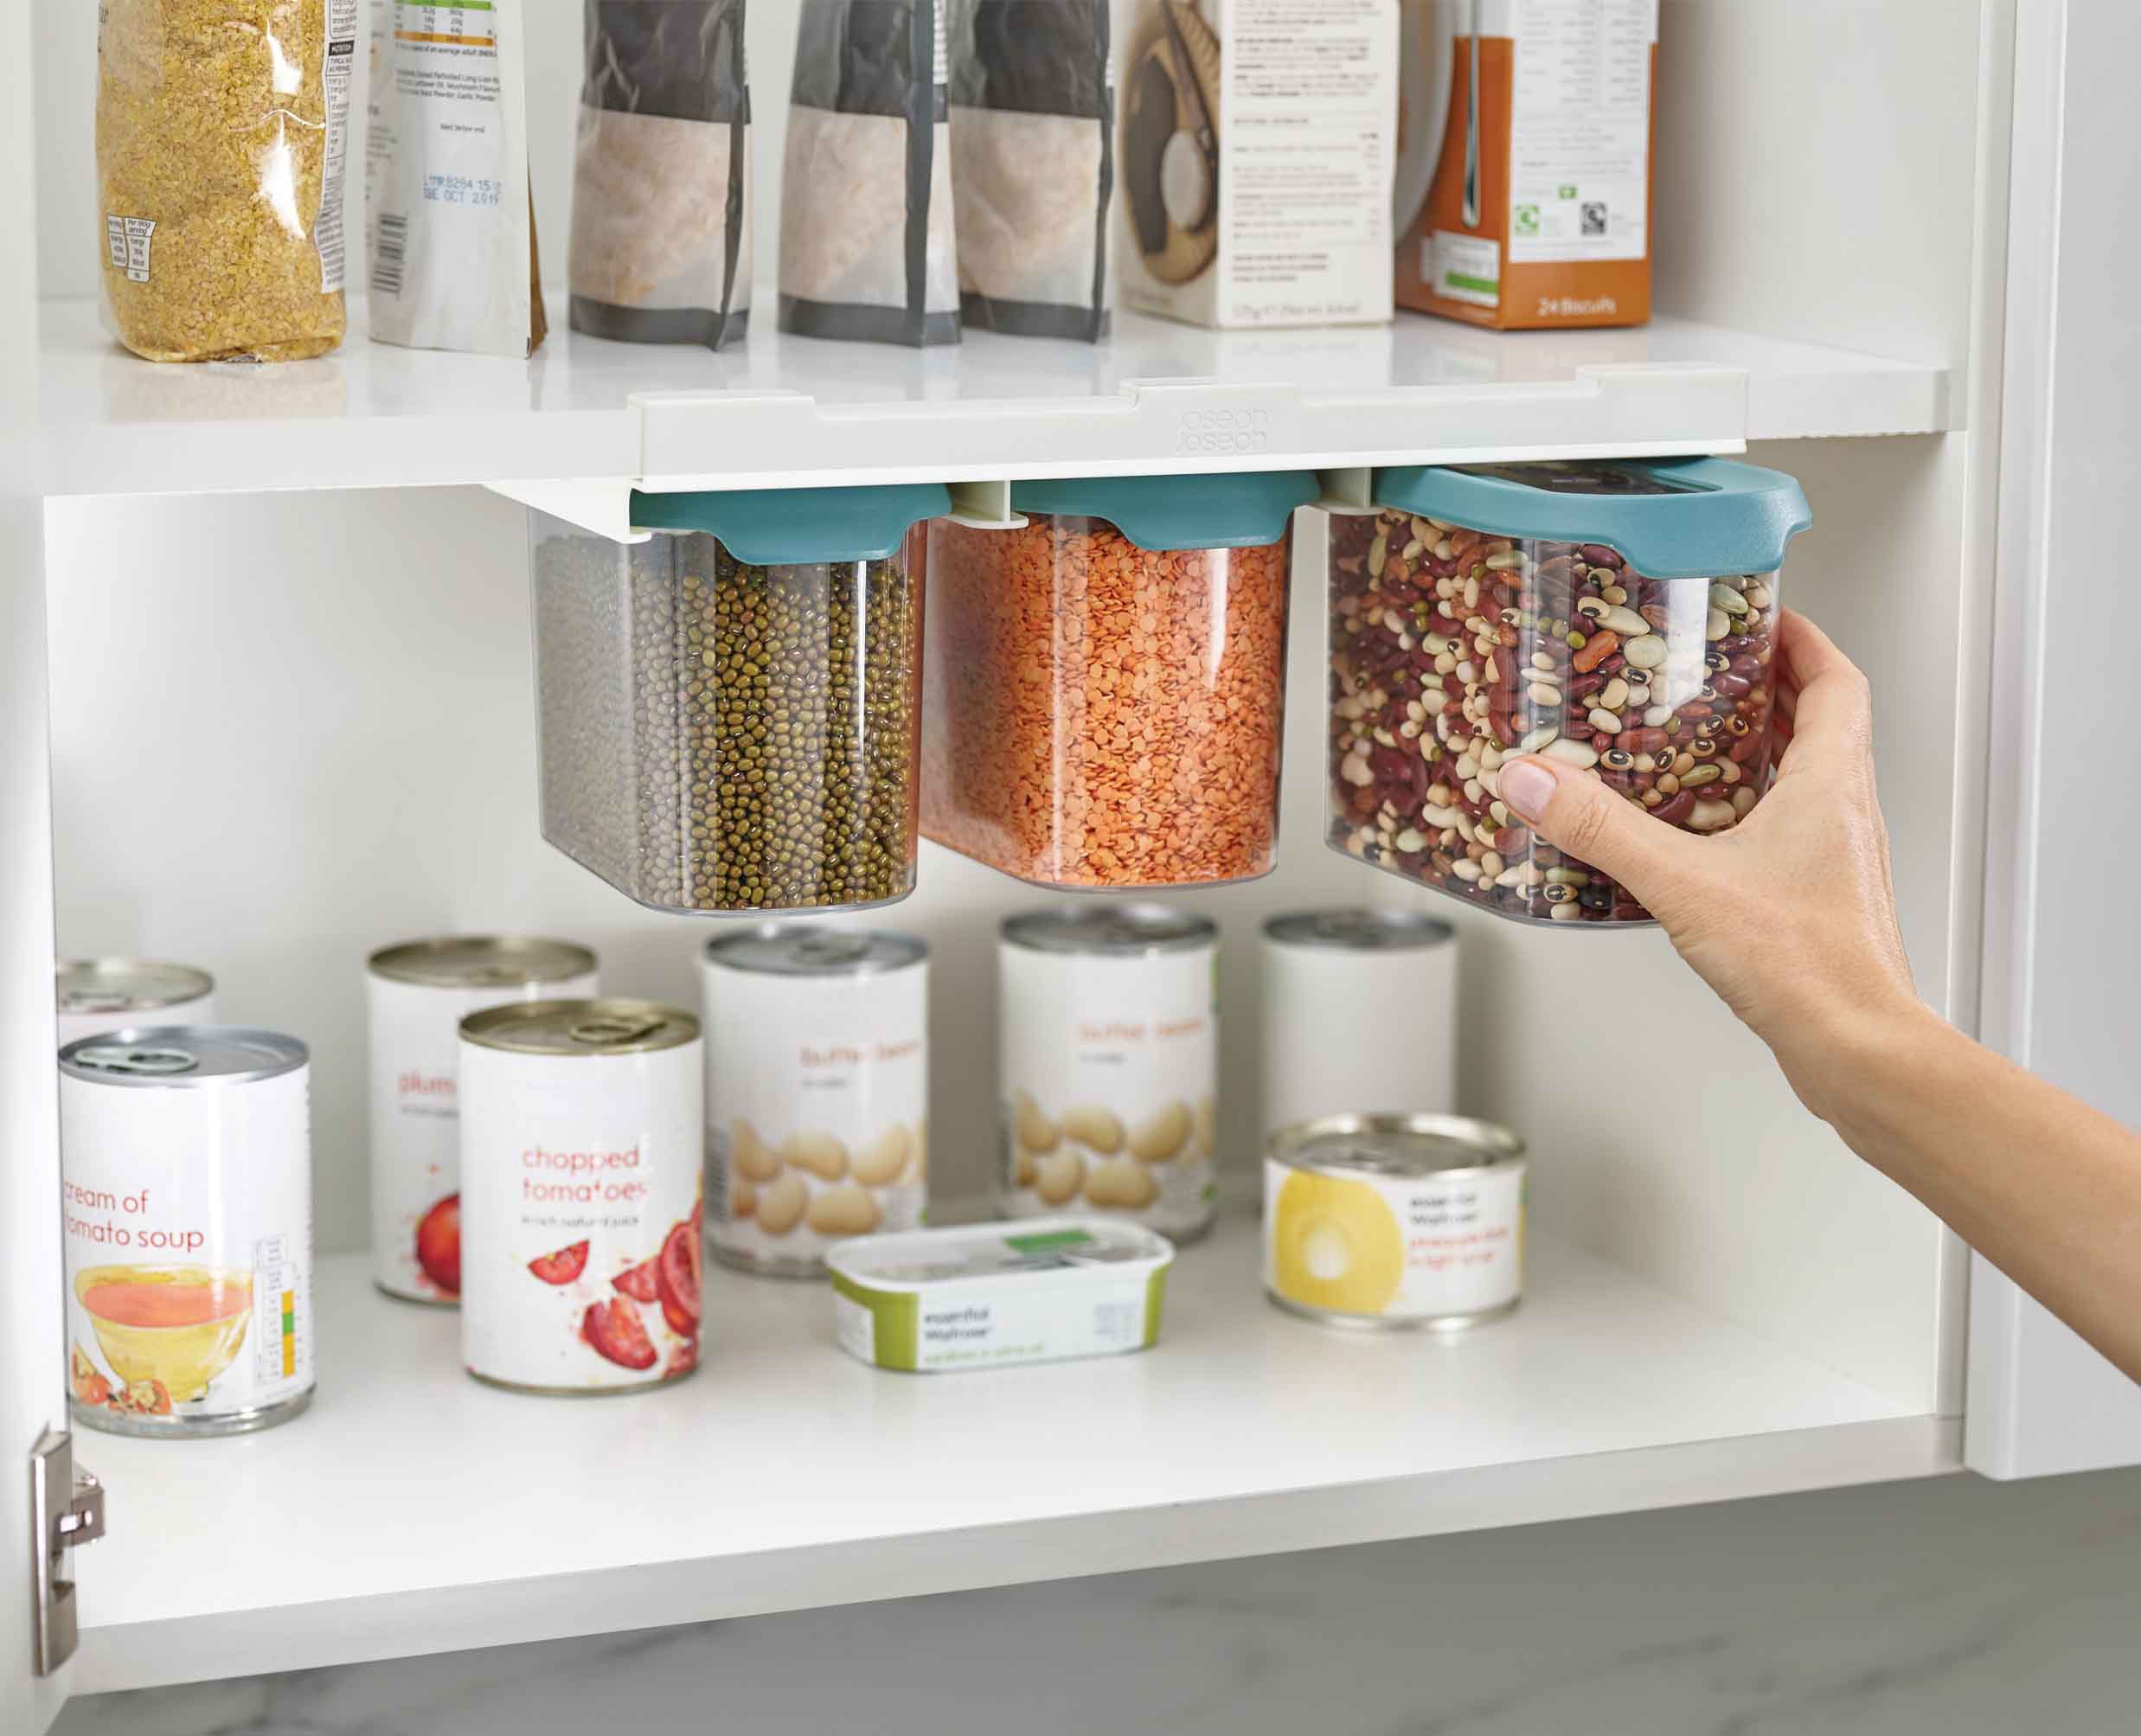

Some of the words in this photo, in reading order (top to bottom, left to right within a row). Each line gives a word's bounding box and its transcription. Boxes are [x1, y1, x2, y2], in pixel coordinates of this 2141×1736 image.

[521, 1143, 640, 1177] chopped
[123, 1188, 150, 1214] of
[138, 1229, 205, 1254] soup
